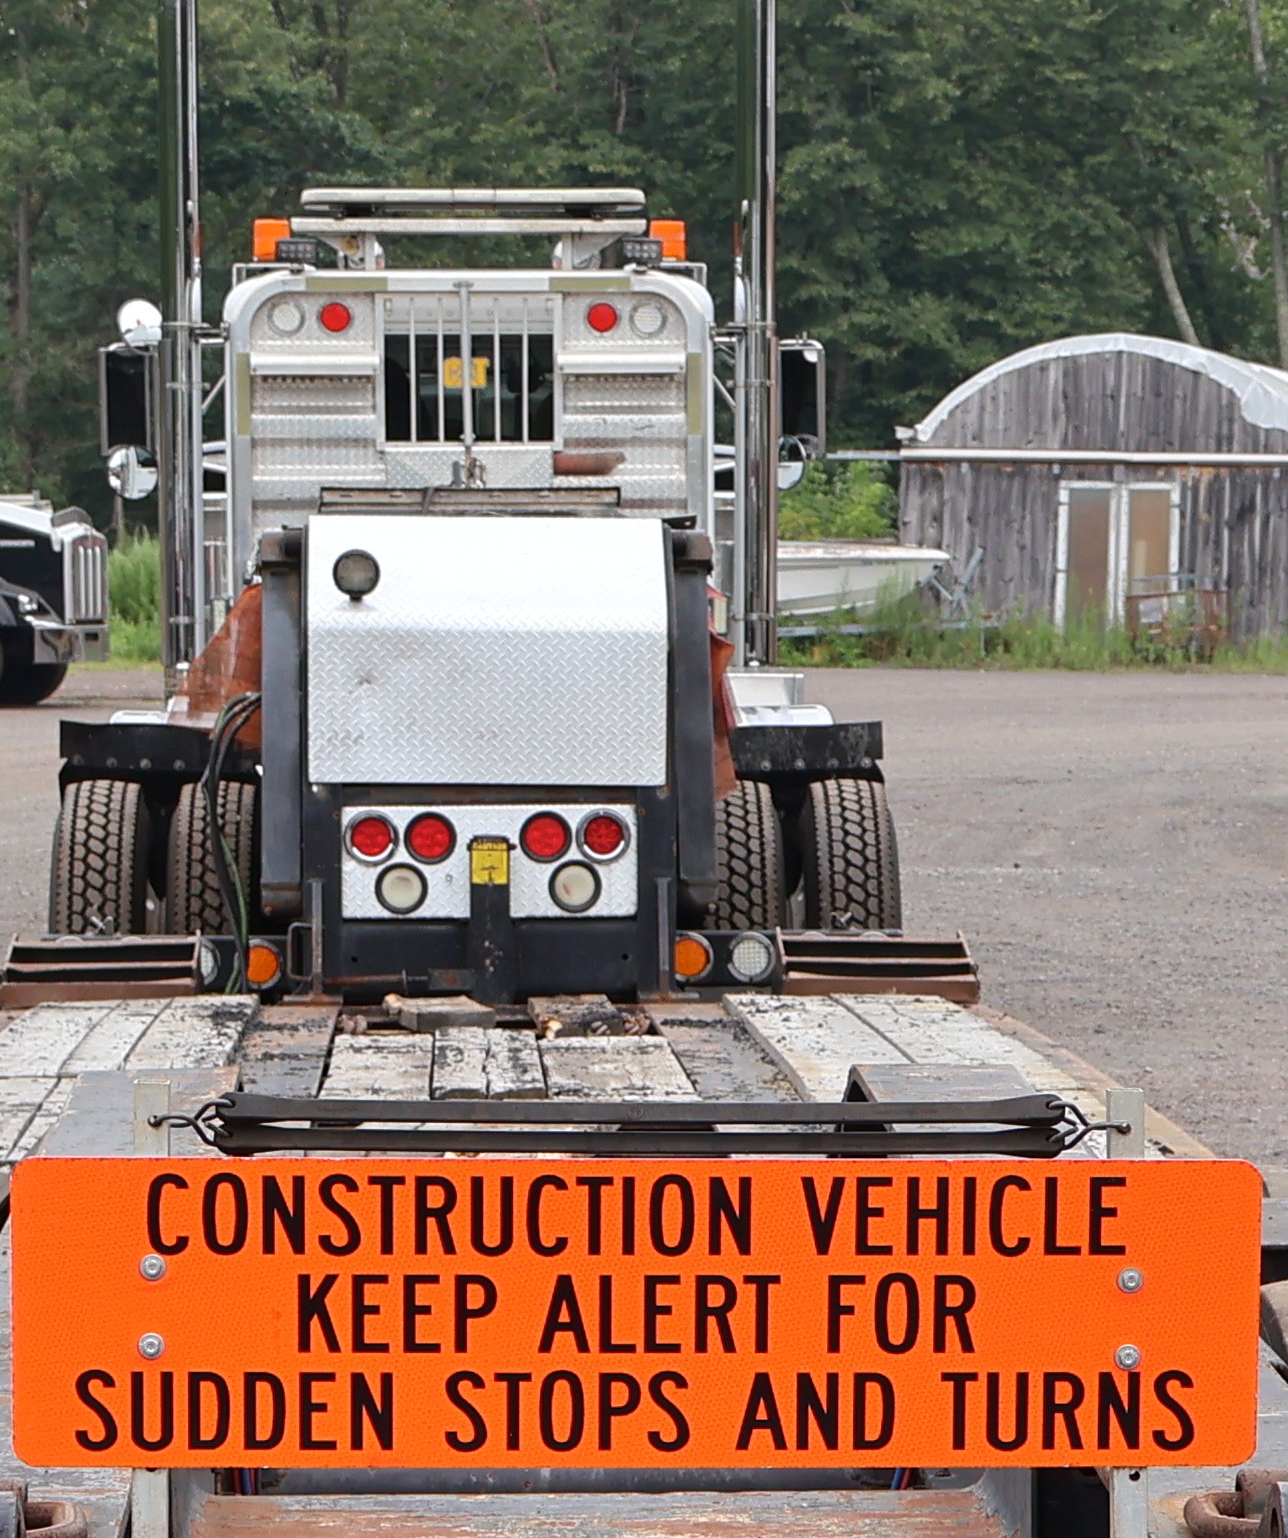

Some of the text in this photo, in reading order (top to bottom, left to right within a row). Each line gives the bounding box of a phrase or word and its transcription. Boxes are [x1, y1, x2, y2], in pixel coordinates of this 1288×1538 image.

[146, 1172, 1128, 1258] CONSTRUCTION VEHICLE
[297, 1272, 977, 1355] KEEP ALERT FOR
[74, 1369, 1195, 1453] SUDDEN STOPS AND TURNS
